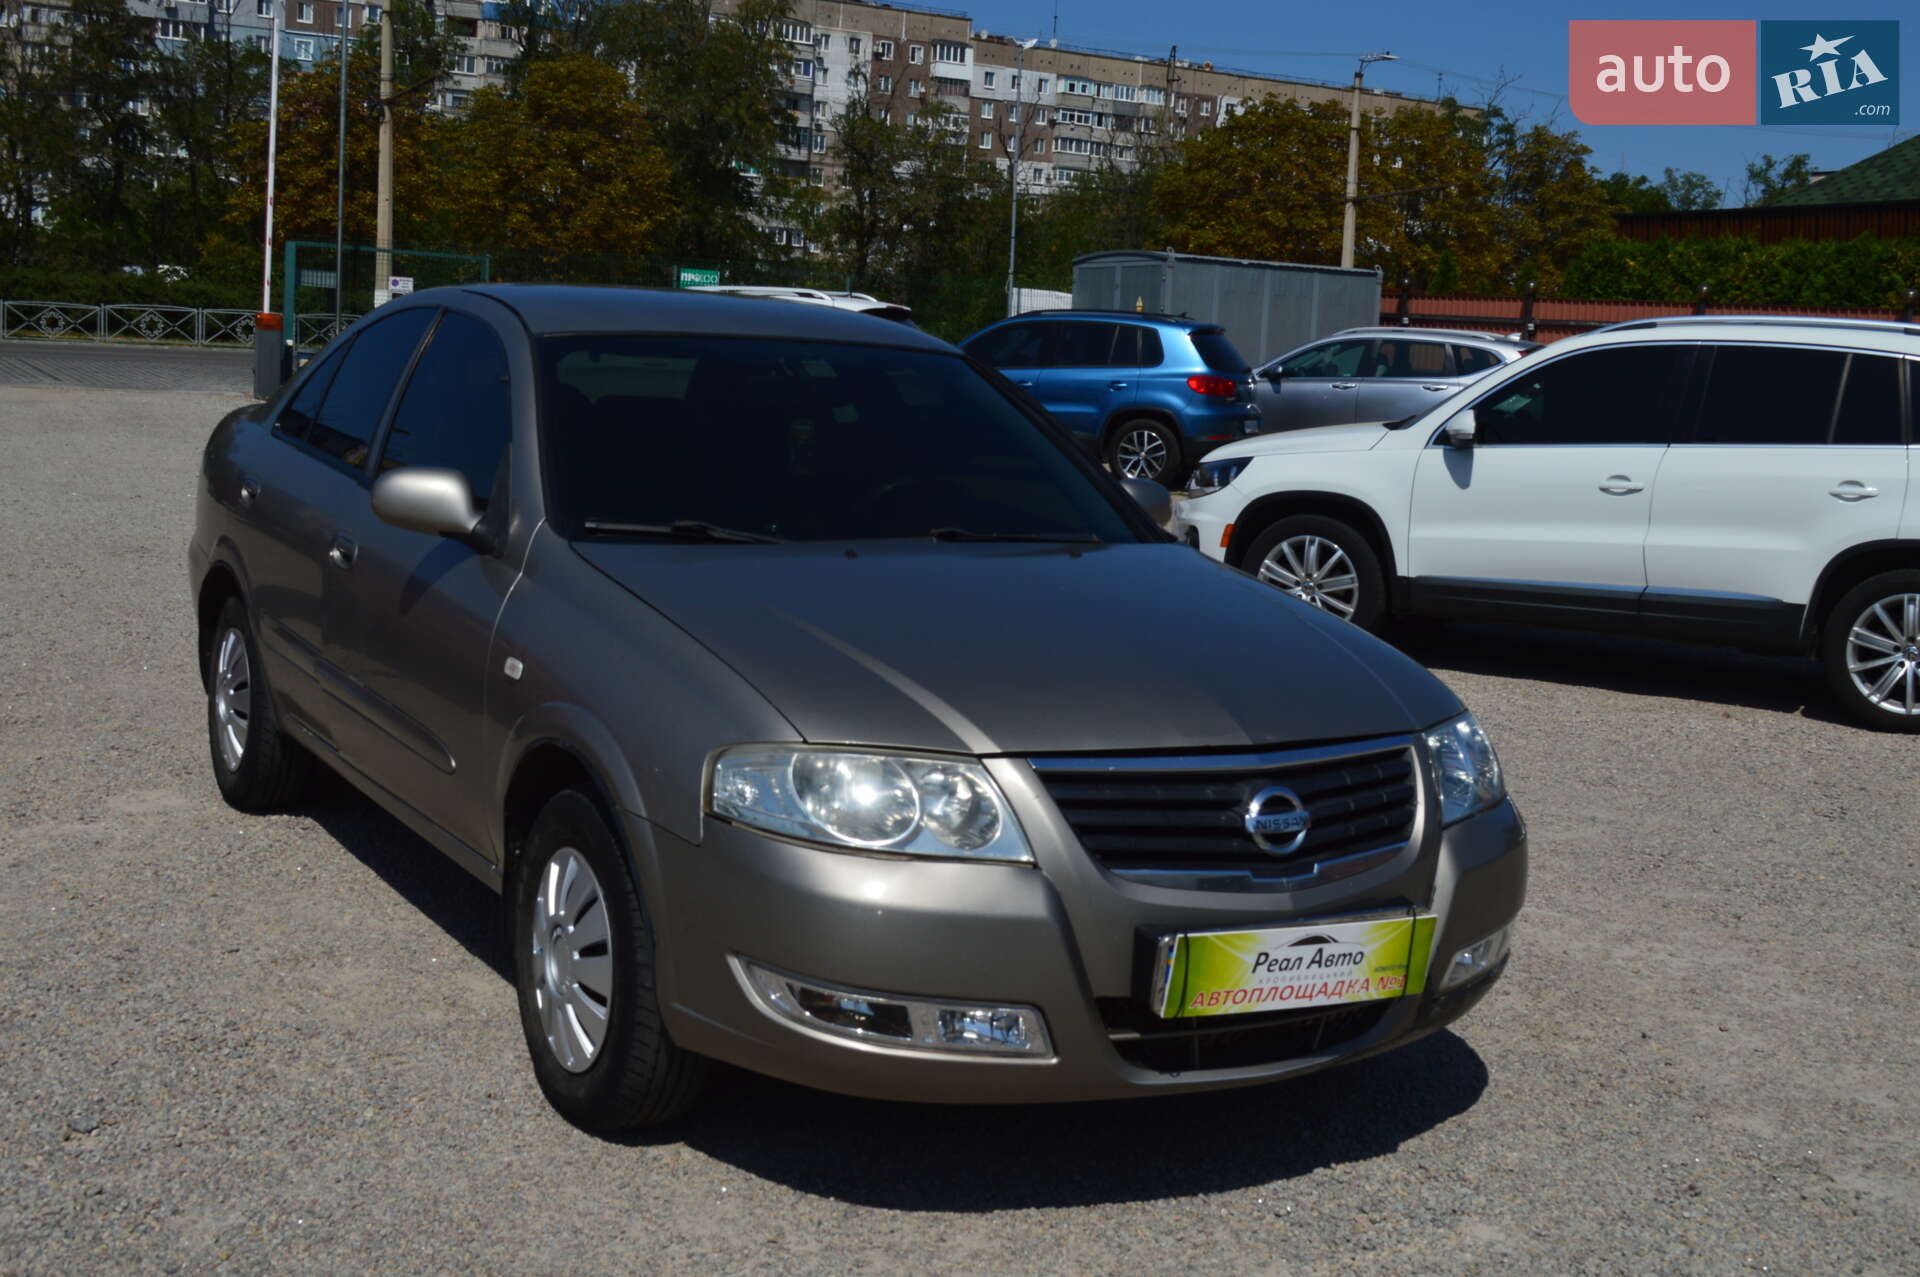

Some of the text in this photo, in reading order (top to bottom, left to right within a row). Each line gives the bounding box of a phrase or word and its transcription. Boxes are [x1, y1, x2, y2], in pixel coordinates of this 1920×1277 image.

[1252, 947, 1365, 974] Реал Авто
[1189, 976, 1371, 1009] АВТОПЛОЩАДКА
